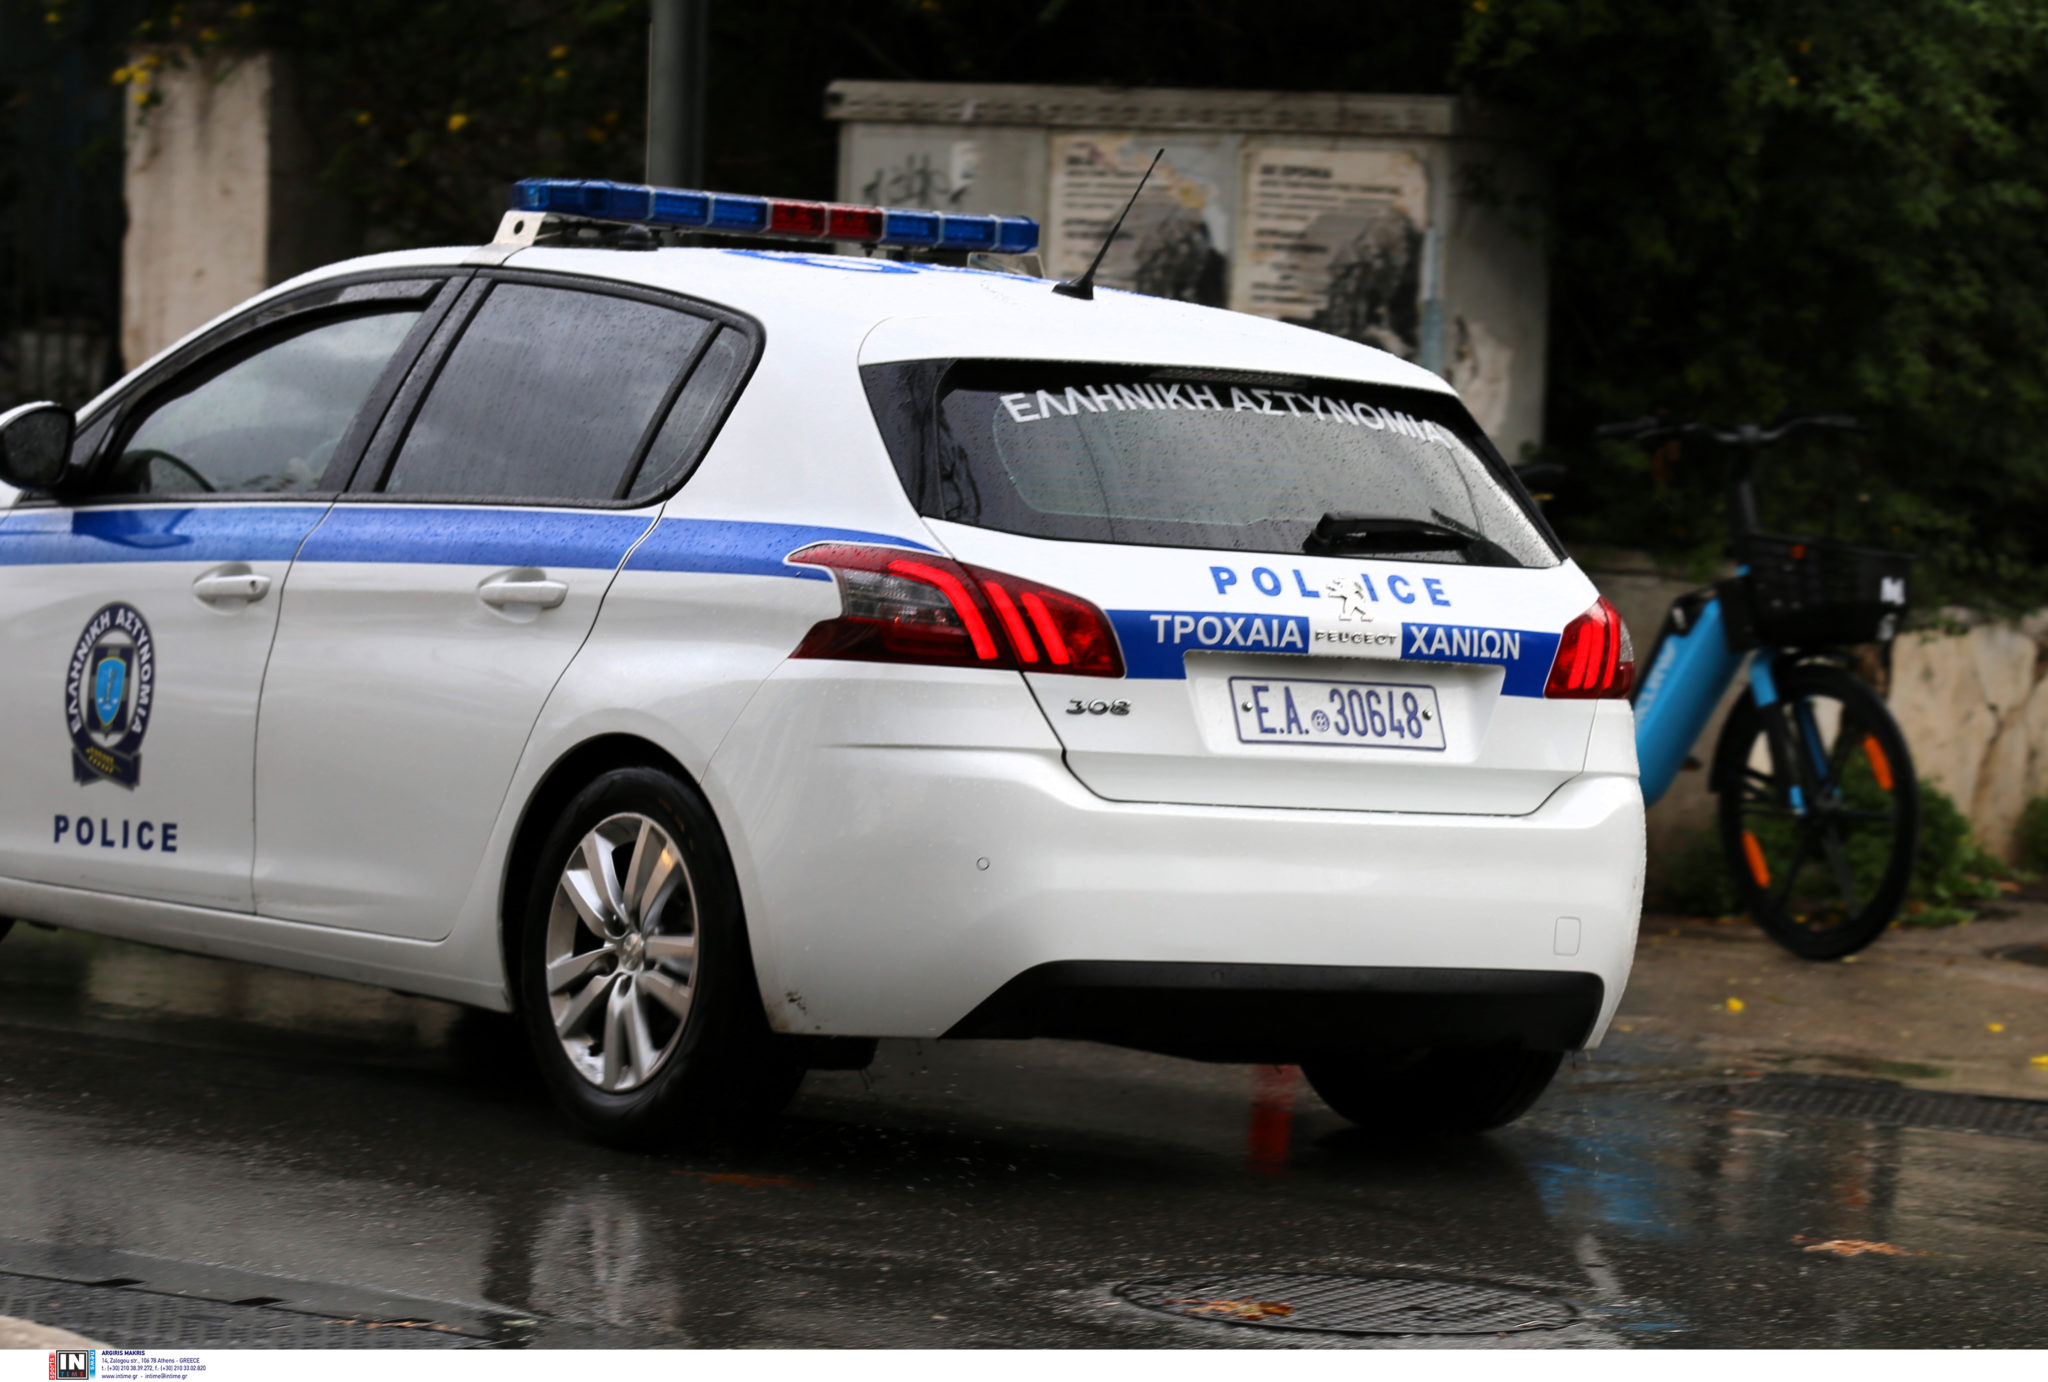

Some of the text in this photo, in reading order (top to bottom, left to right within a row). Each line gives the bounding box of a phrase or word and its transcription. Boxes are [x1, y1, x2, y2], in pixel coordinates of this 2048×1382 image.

[1000, 383, 1452, 449] ΕΛΛΗΝΙΚΗ ΑΣΤΥΝΟΜΙΑ
[1209, 565, 1451, 607] POLICE
[1149, 614, 1304, 648] ΤΡΟΧΑΙΑ
[1314, 629, 1398, 646] PEUGEOT
[1409, 625, 1520, 660] ΧΑΝΙΩΝ
[68, 607, 152, 734] ΕΛΛΗΝΙΚΗ ΑΣΤΥΝΟΜΙΑ
[1065, 698, 1131, 716] 308
[1329, 688, 1423, 739] 30648
[53, 813, 178, 853] POLICE
